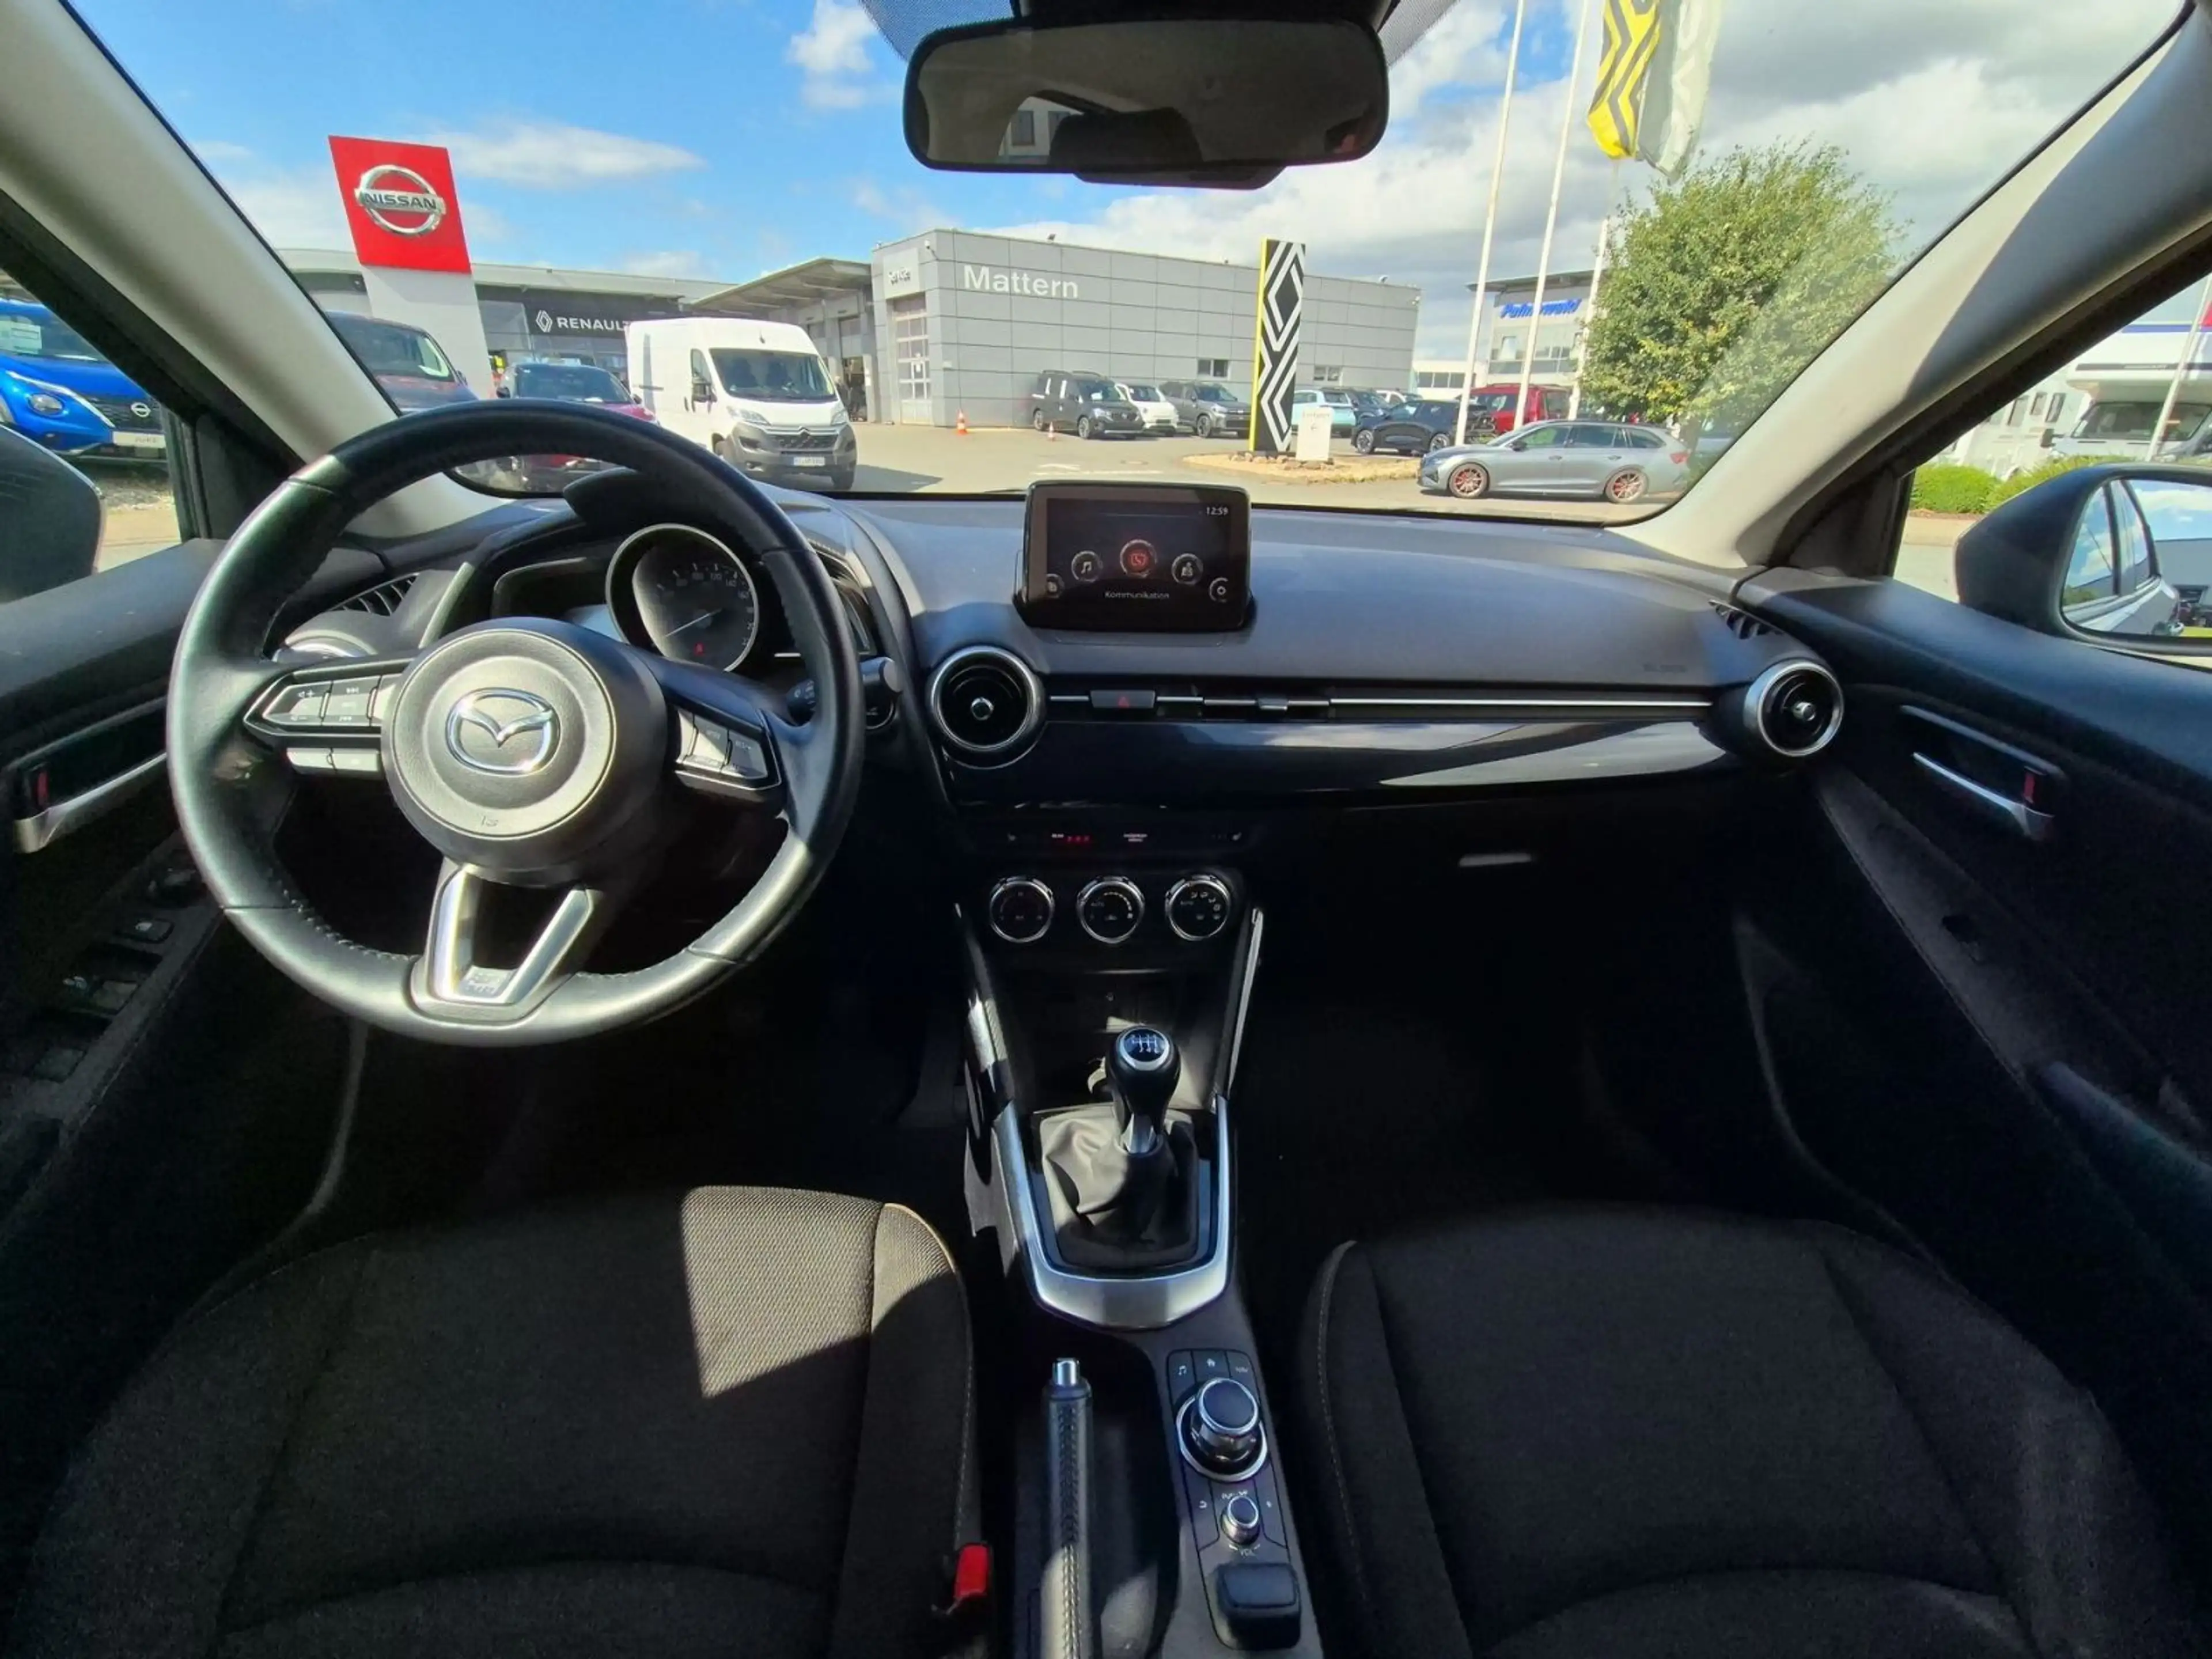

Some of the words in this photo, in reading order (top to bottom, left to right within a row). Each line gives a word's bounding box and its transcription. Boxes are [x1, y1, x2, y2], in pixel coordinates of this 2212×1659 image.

[364, 193, 437, 210] NISSAN
[964, 264, 1078, 298] Mattern
[1206, 506, 1229, 516] 12:59
